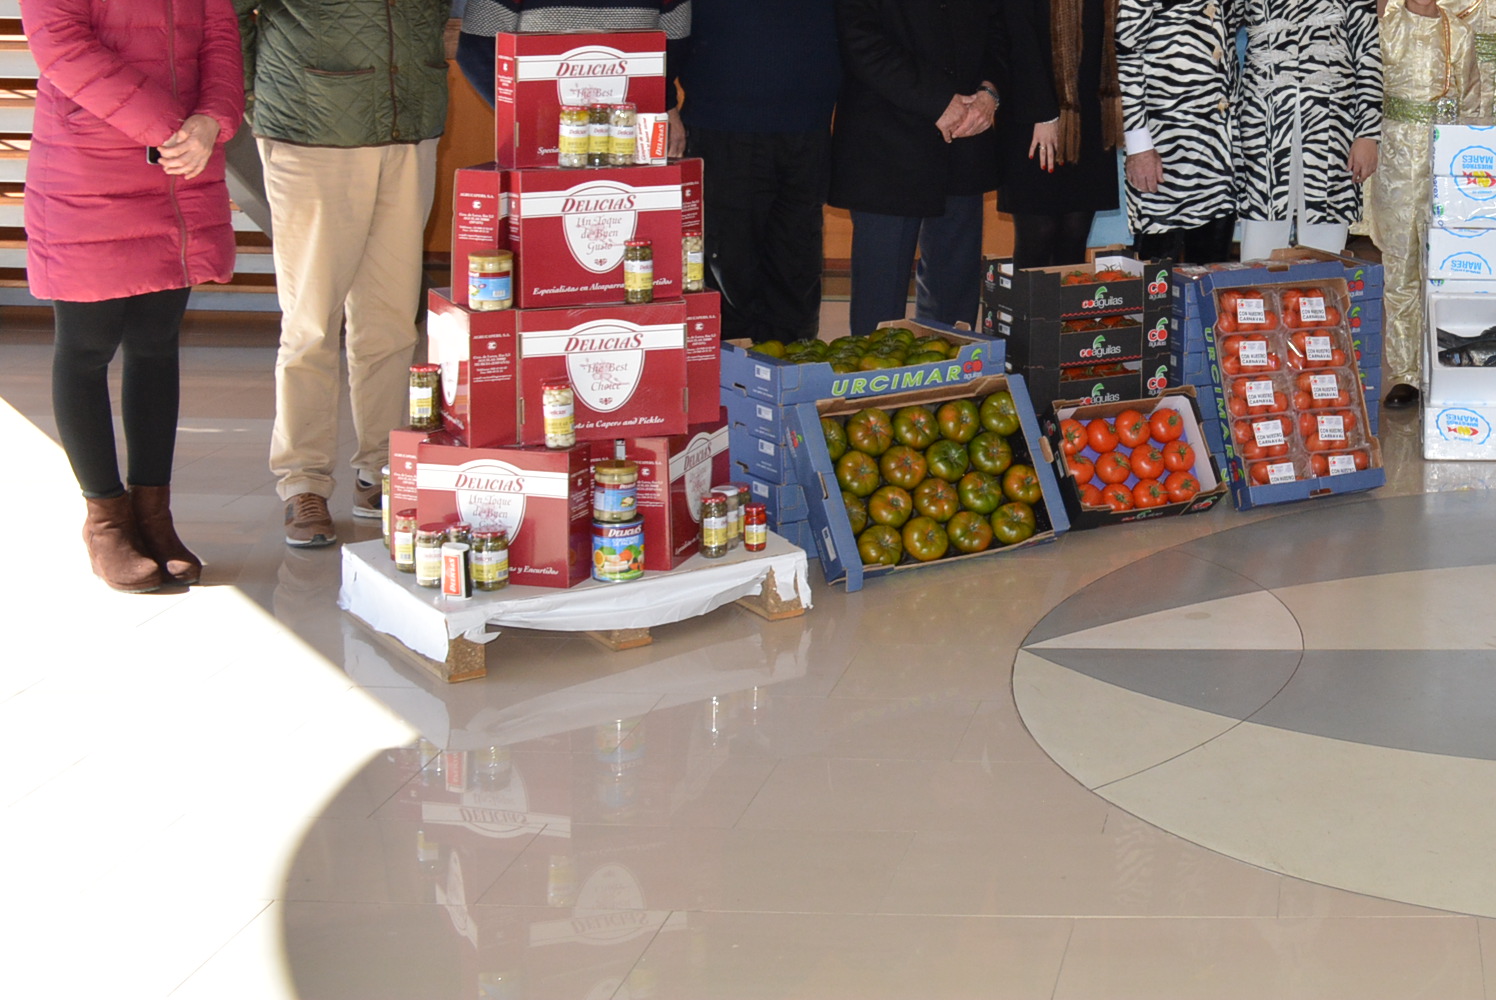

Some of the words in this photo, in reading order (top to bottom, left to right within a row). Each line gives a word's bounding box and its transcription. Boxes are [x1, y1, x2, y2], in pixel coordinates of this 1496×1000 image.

[556, 60, 628, 77] DELICIAS
[1462, 154, 1494, 164] MARES
[561, 194, 636, 213] DELICIAS
[533, 283, 578, 296] Especialistas
[589, 281, 626, 292] Alcaparra
[564, 333, 644, 352] DELICIAS
[608, 362, 628, 373] Best
[831, 364, 962, 397] URCIMAR
[1204, 327, 1235, 460] URCIMAR
[586, 421, 594, 429] in
[595, 419, 621, 431] Capers
[622, 417, 637, 426] and
[638, 415, 665, 425] Pickles
[455, 473, 525, 492] DELICIAS
[523, 565, 559, 576] Encurtidos
